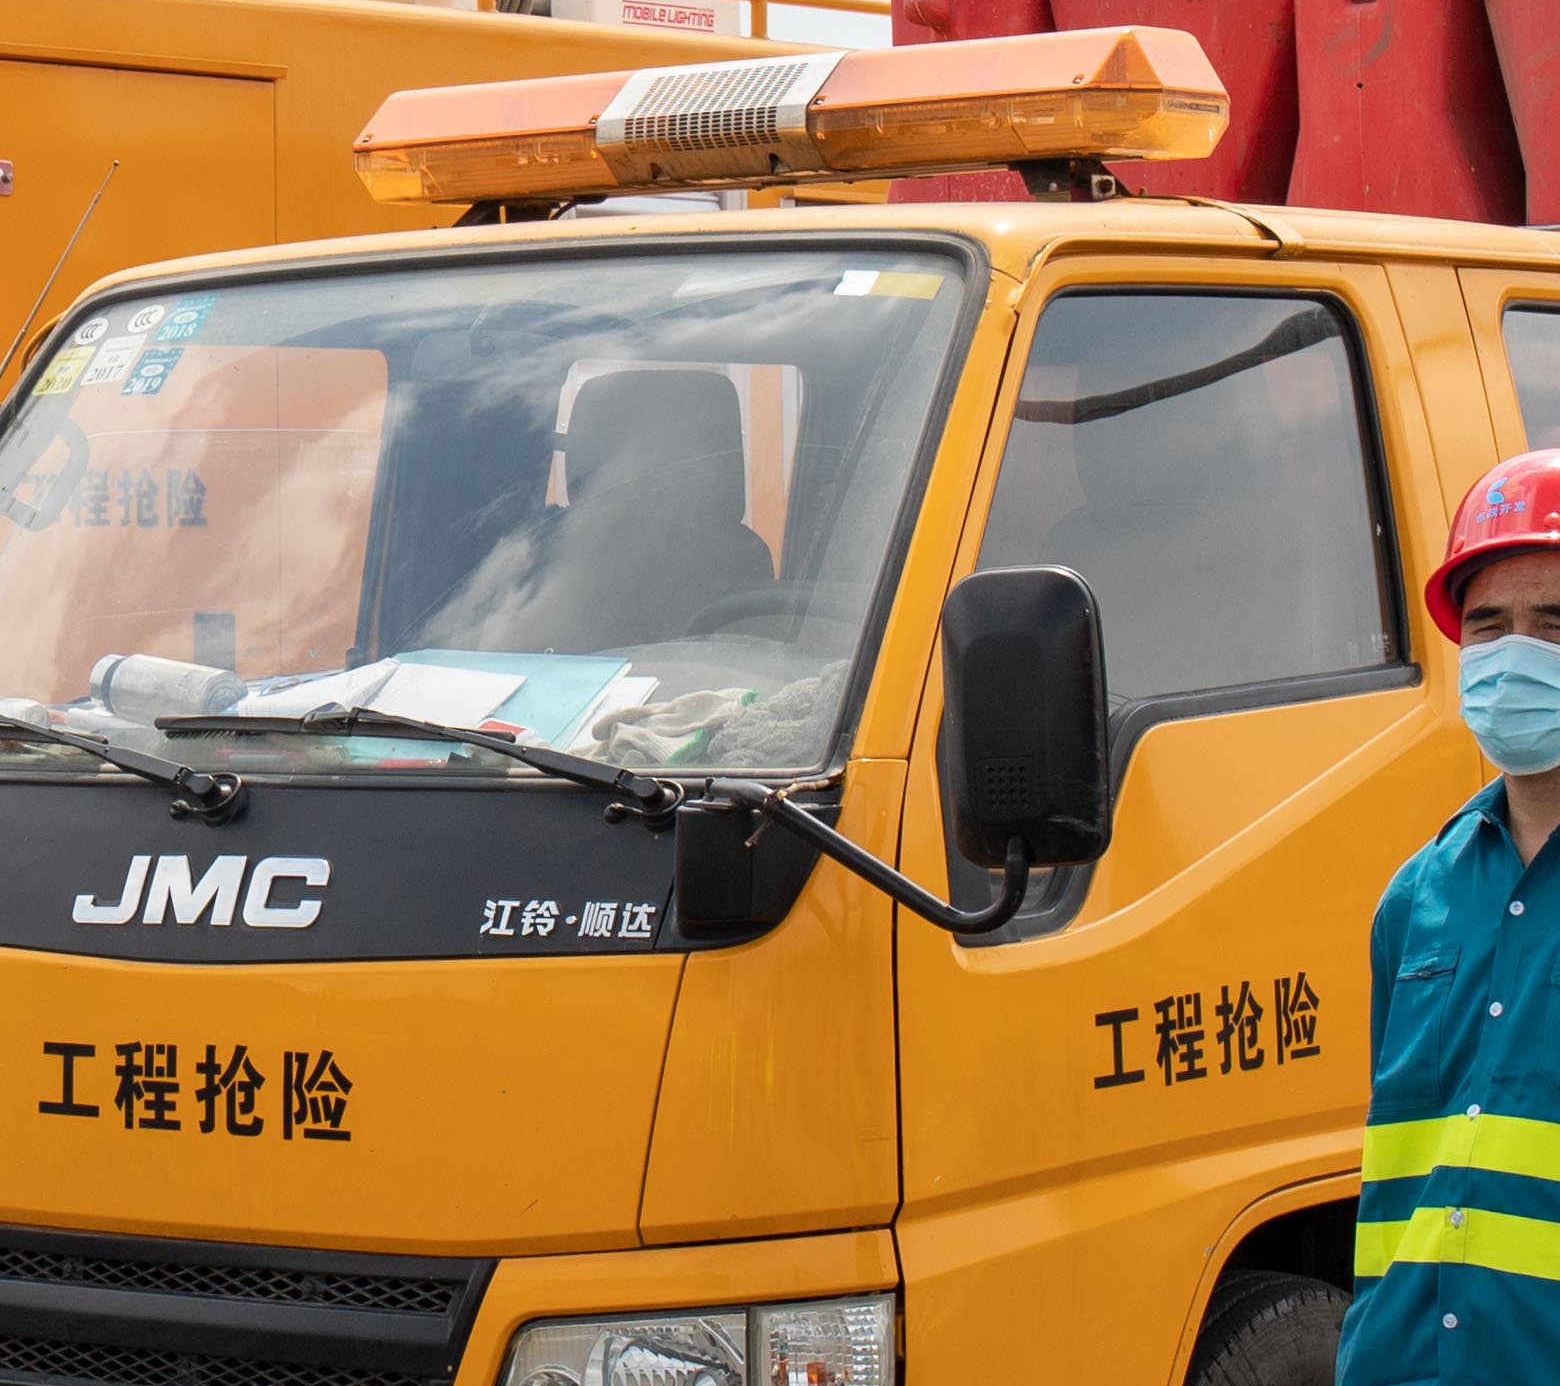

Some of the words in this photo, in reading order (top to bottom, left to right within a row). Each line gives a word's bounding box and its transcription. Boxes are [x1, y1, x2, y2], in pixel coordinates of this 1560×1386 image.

[156, 323, 194, 341] 2018
[87, 364, 124, 382] 2017
[125, 376, 162, 394] 2019
[72, 855, 331, 927] JMC
[480, 899, 656, 938] 江铃·顺达
[1094, 972, 1320, 1089] 工程抢险
[39, 1041, 353, 1141] 工程抢险
